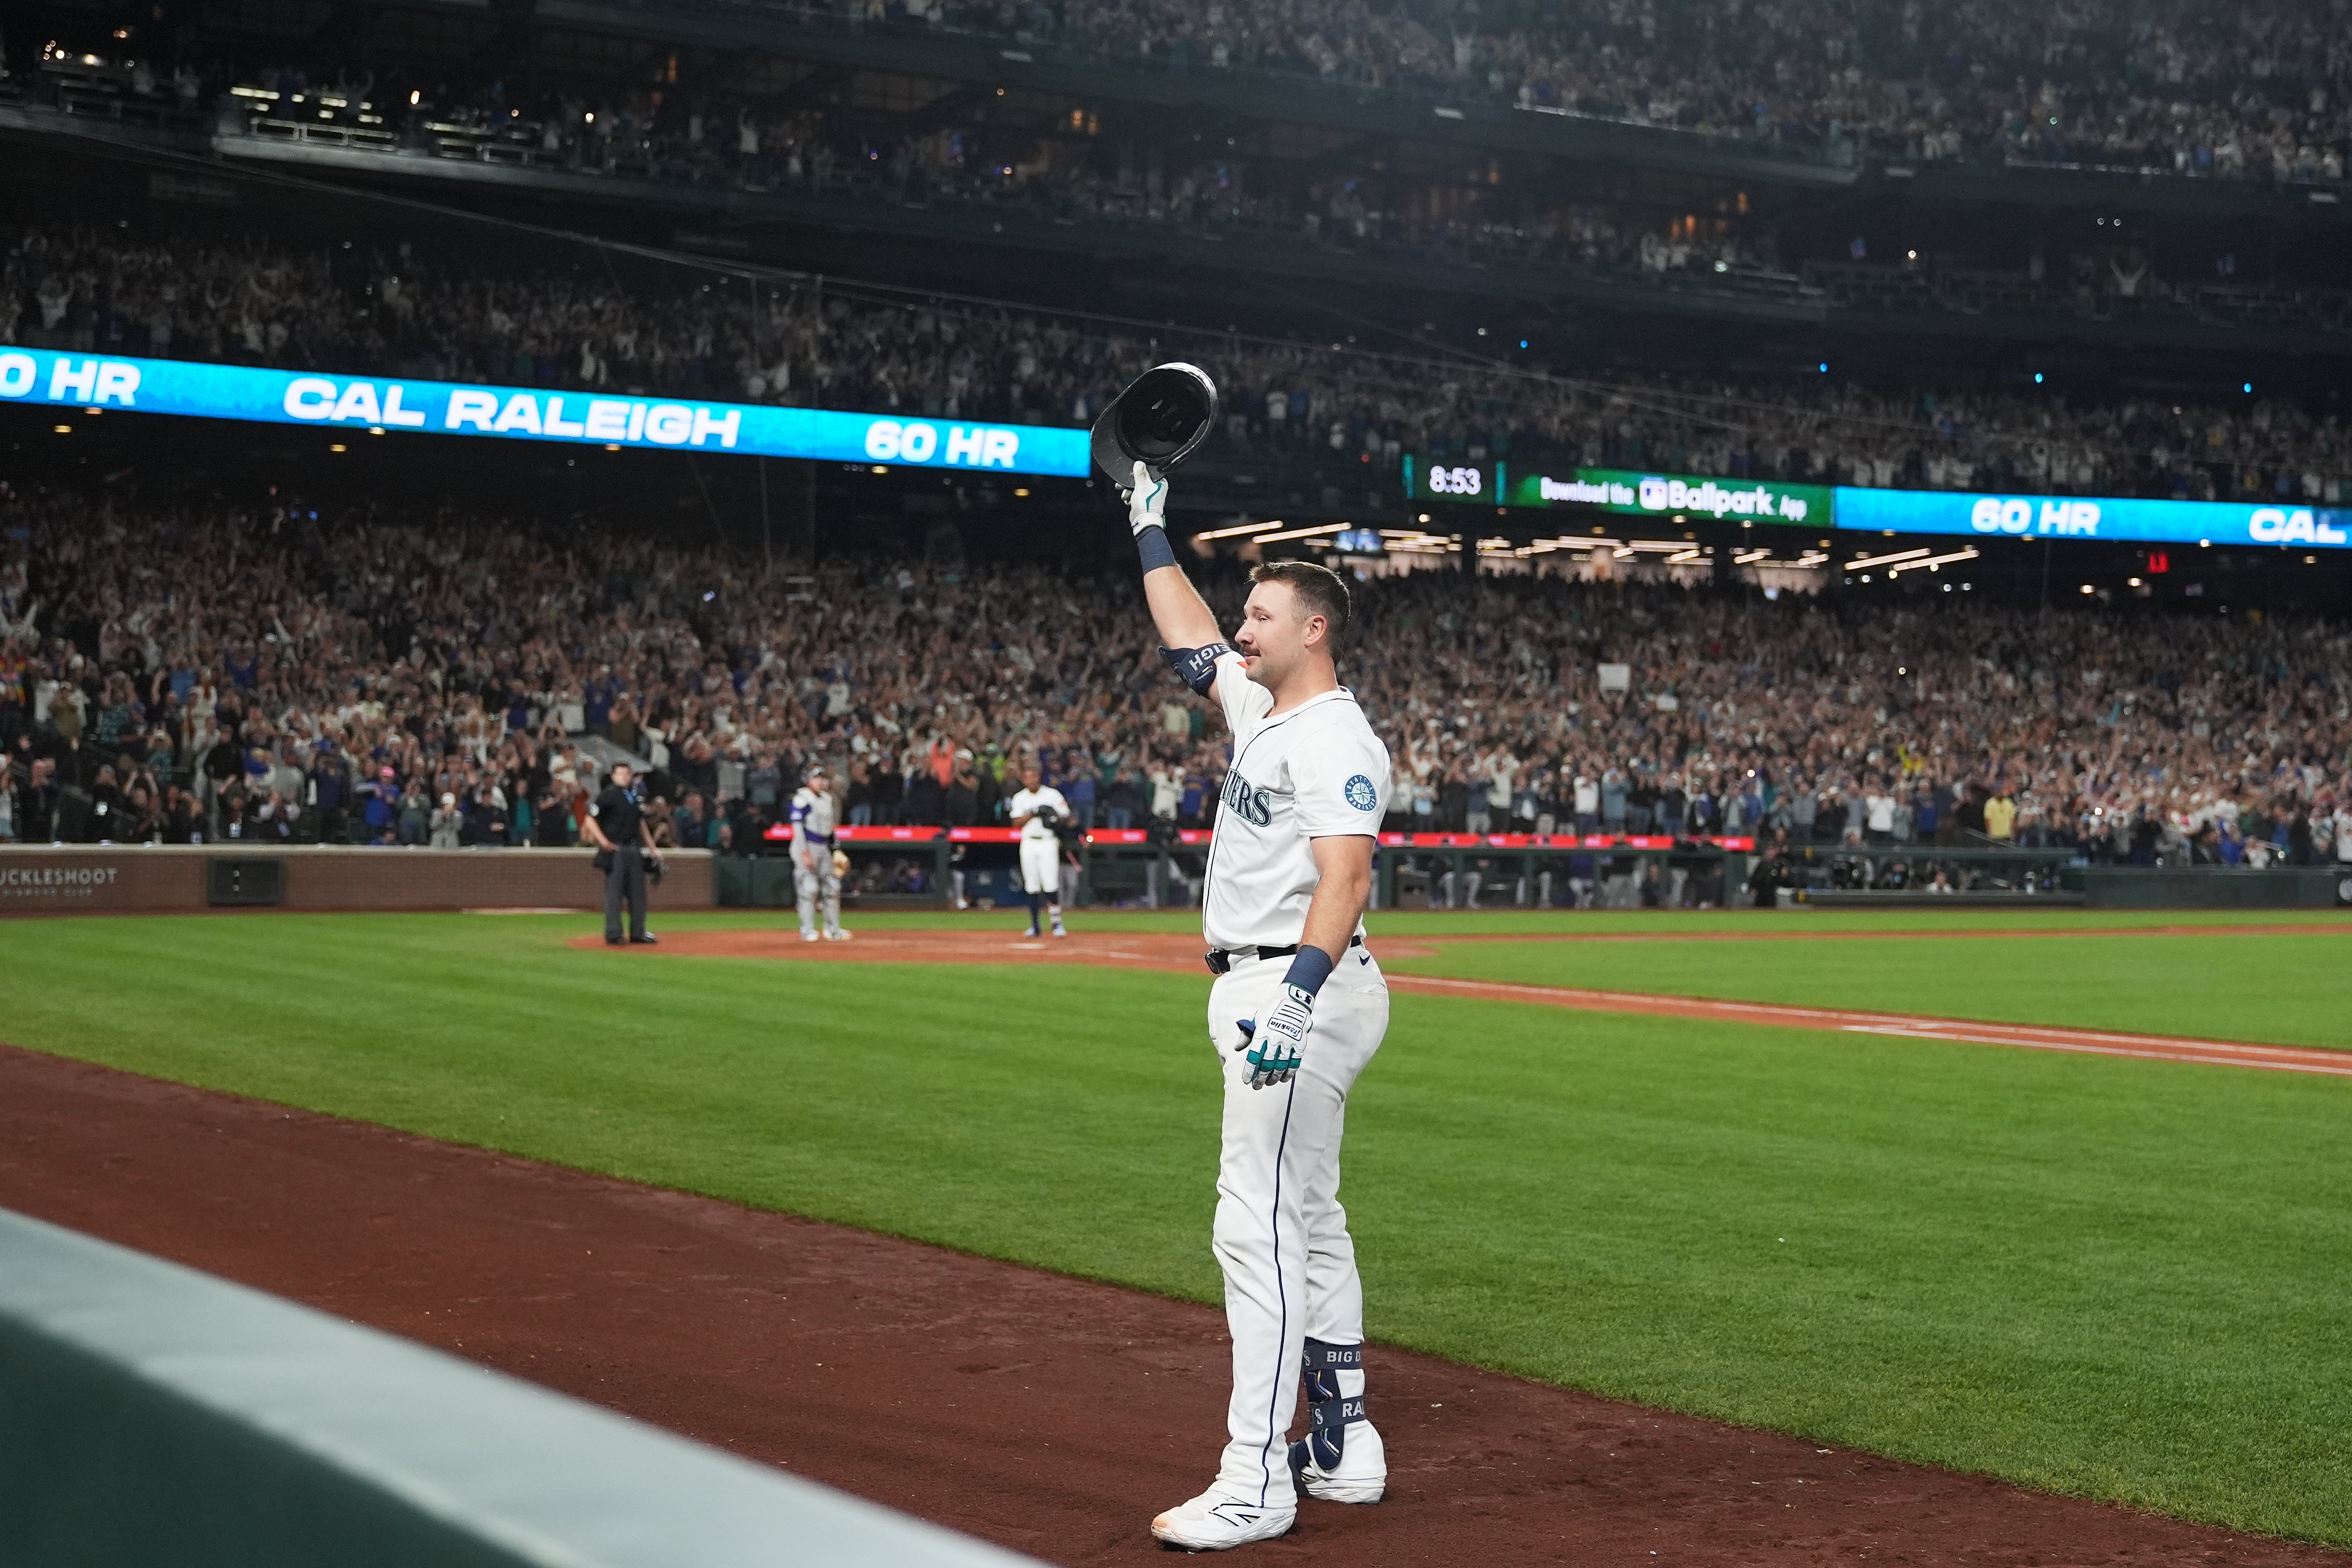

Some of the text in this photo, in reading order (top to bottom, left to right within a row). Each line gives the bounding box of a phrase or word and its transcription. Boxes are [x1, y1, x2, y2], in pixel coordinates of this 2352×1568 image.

[50, 358, 141, 404] HR
[284, 378, 741, 448] CAL RALEIGH
[866, 421, 1019, 468] 60 HR
[1429, 466, 1481, 495] 8:53
[1541, 477, 1807, 521] Download the Ballpark App
[1972, 498, 2101, 535] 60 HR
[2249, 508, 2347, 544] CAL
[1347, 776, 1373, 790] SEATTLE
[1348, 796, 1376, 810] MARINERS
[1270, 1021, 1301, 1038] Franklin
[1327, 1351, 1353, 1363] BIG
